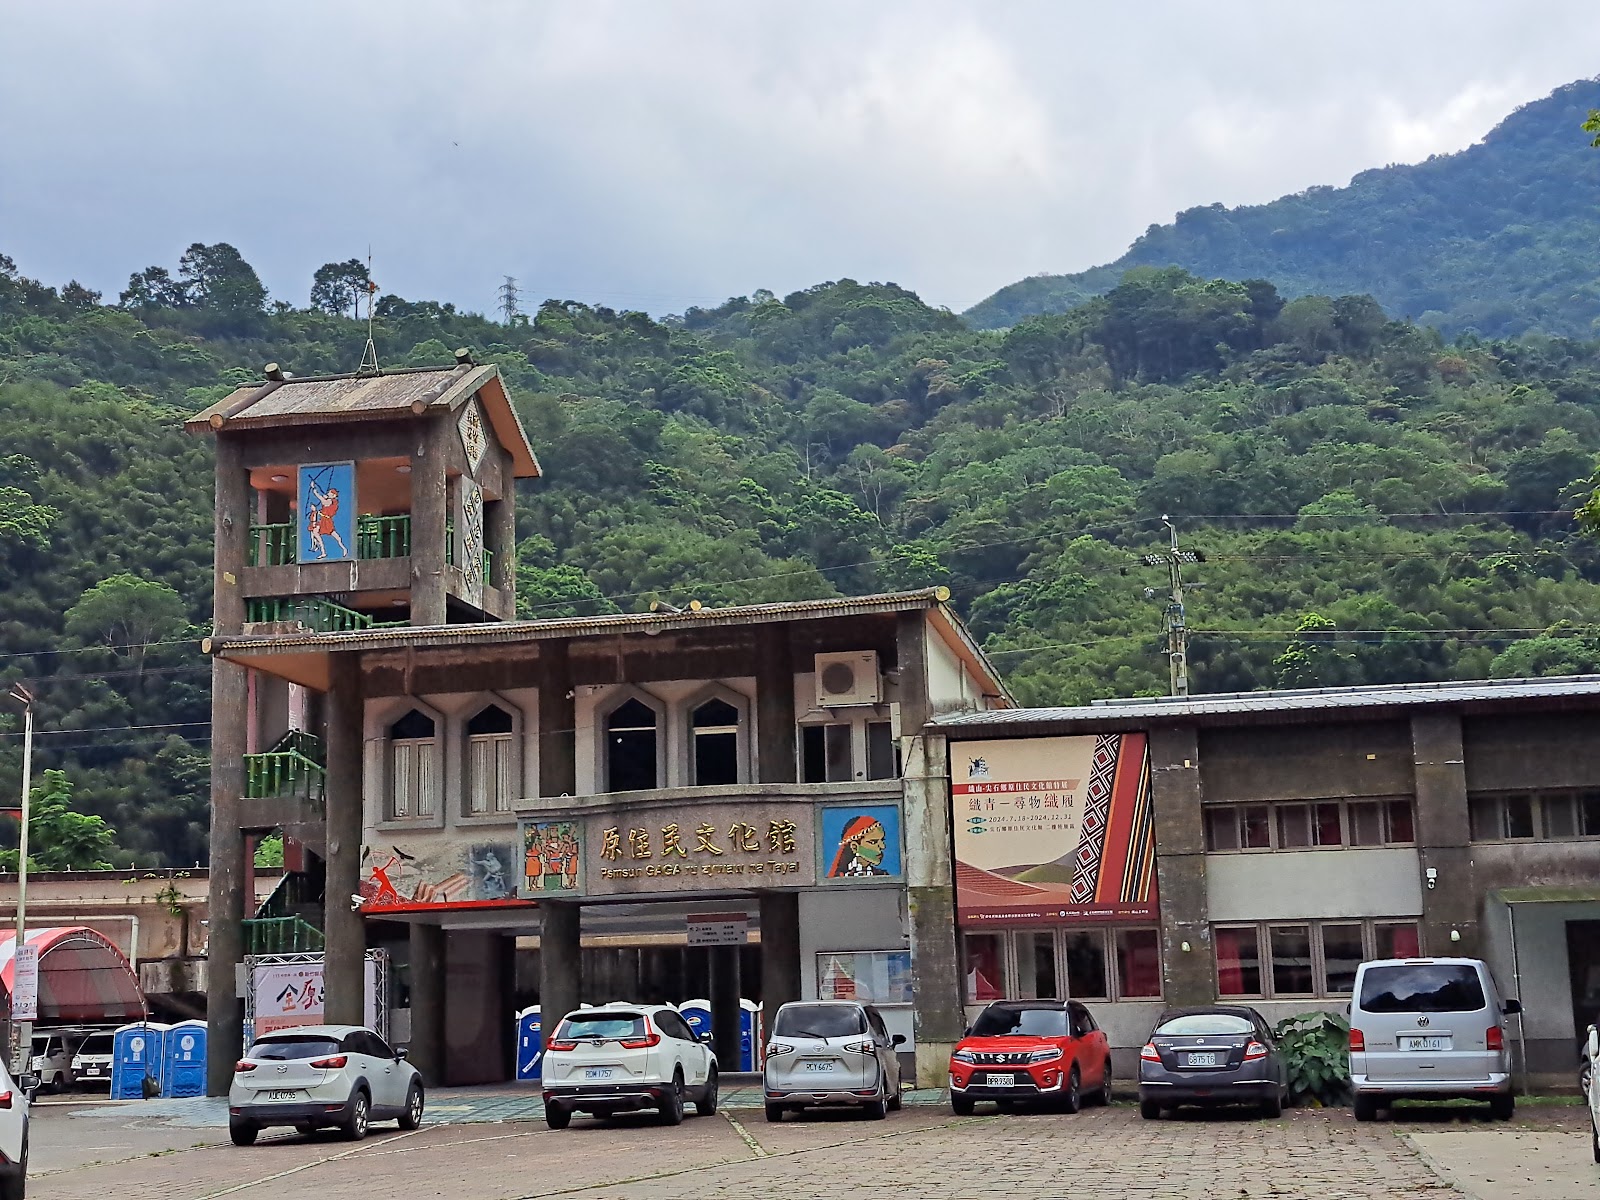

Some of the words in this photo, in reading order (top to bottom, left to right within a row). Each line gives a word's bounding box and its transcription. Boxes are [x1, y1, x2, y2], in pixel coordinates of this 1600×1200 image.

[600, 819, 798, 861] 原住民文化館
[645, 863, 681, 876] GAGA
[767, 860, 799, 875] Tayal
